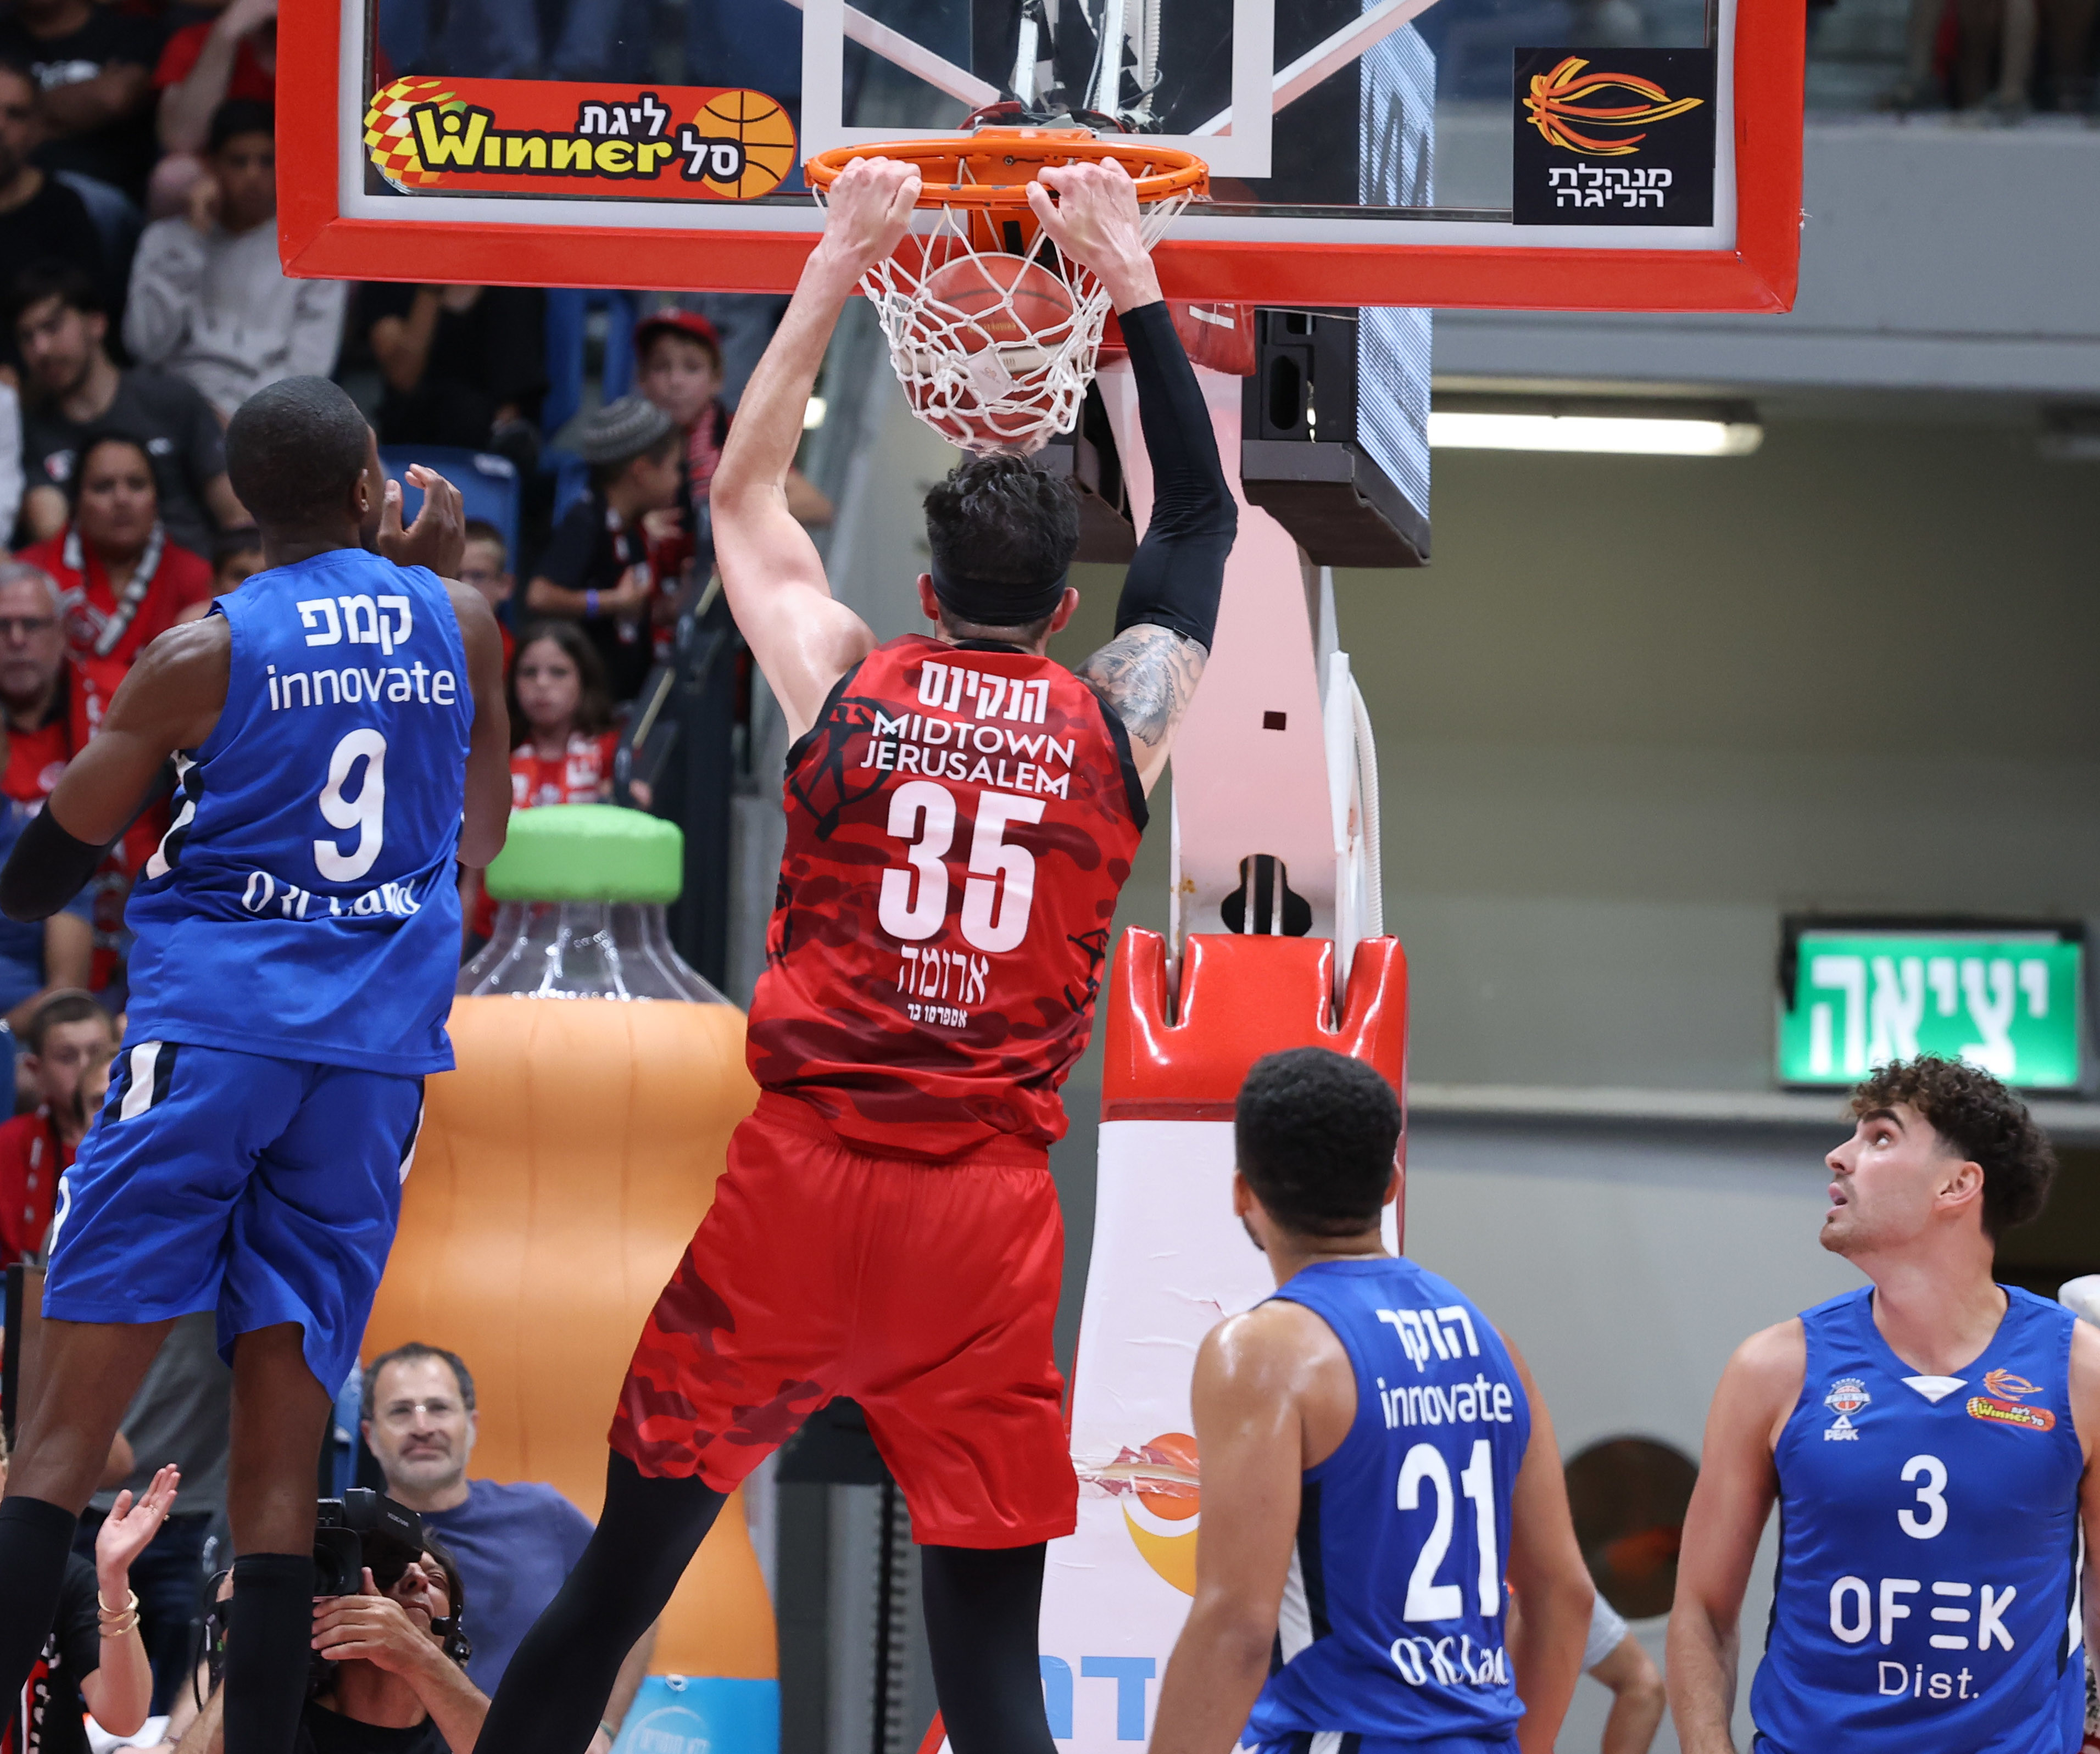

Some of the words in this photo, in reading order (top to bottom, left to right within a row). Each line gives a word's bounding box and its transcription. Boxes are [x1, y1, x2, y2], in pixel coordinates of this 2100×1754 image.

[413, 108, 672, 173] Winner
[682, 131, 738, 175] סל
[580, 98, 666, 136] ליגת
[1548, 163, 1672, 189] מנהלת
[1556, 185, 1664, 208] הליגה
[296, 594, 413, 655] קמפ
[267, 661, 456, 711] innovate
[917, 660, 1050, 724] הנקינס
[872, 710, 1076, 768] MIDTOWN
[860, 740, 1070, 800] JERUSALEM
[314, 728, 387, 882] 9
[878, 780, 1046, 953] 35
[896, 944, 989, 1005] ארומה
[907, 1003, 921, 1021] בר
[924, 1004, 968, 1029] אספרסו
[1809, 954, 2049, 1077] יציאה
[1375, 1305, 1480, 1373] הוקר
[1377, 1373, 1513, 1429] innovate
[1978, 1402, 2031, 1423] Winner
[1824, 1428, 1861, 1441] PEAK
[1898, 1454, 1948, 1539] 3
[1397, 1439, 1500, 1622] 21
[1829, 1576, 2017, 1651] OFEK
[1879, 1661, 1980, 1699] Dist.
